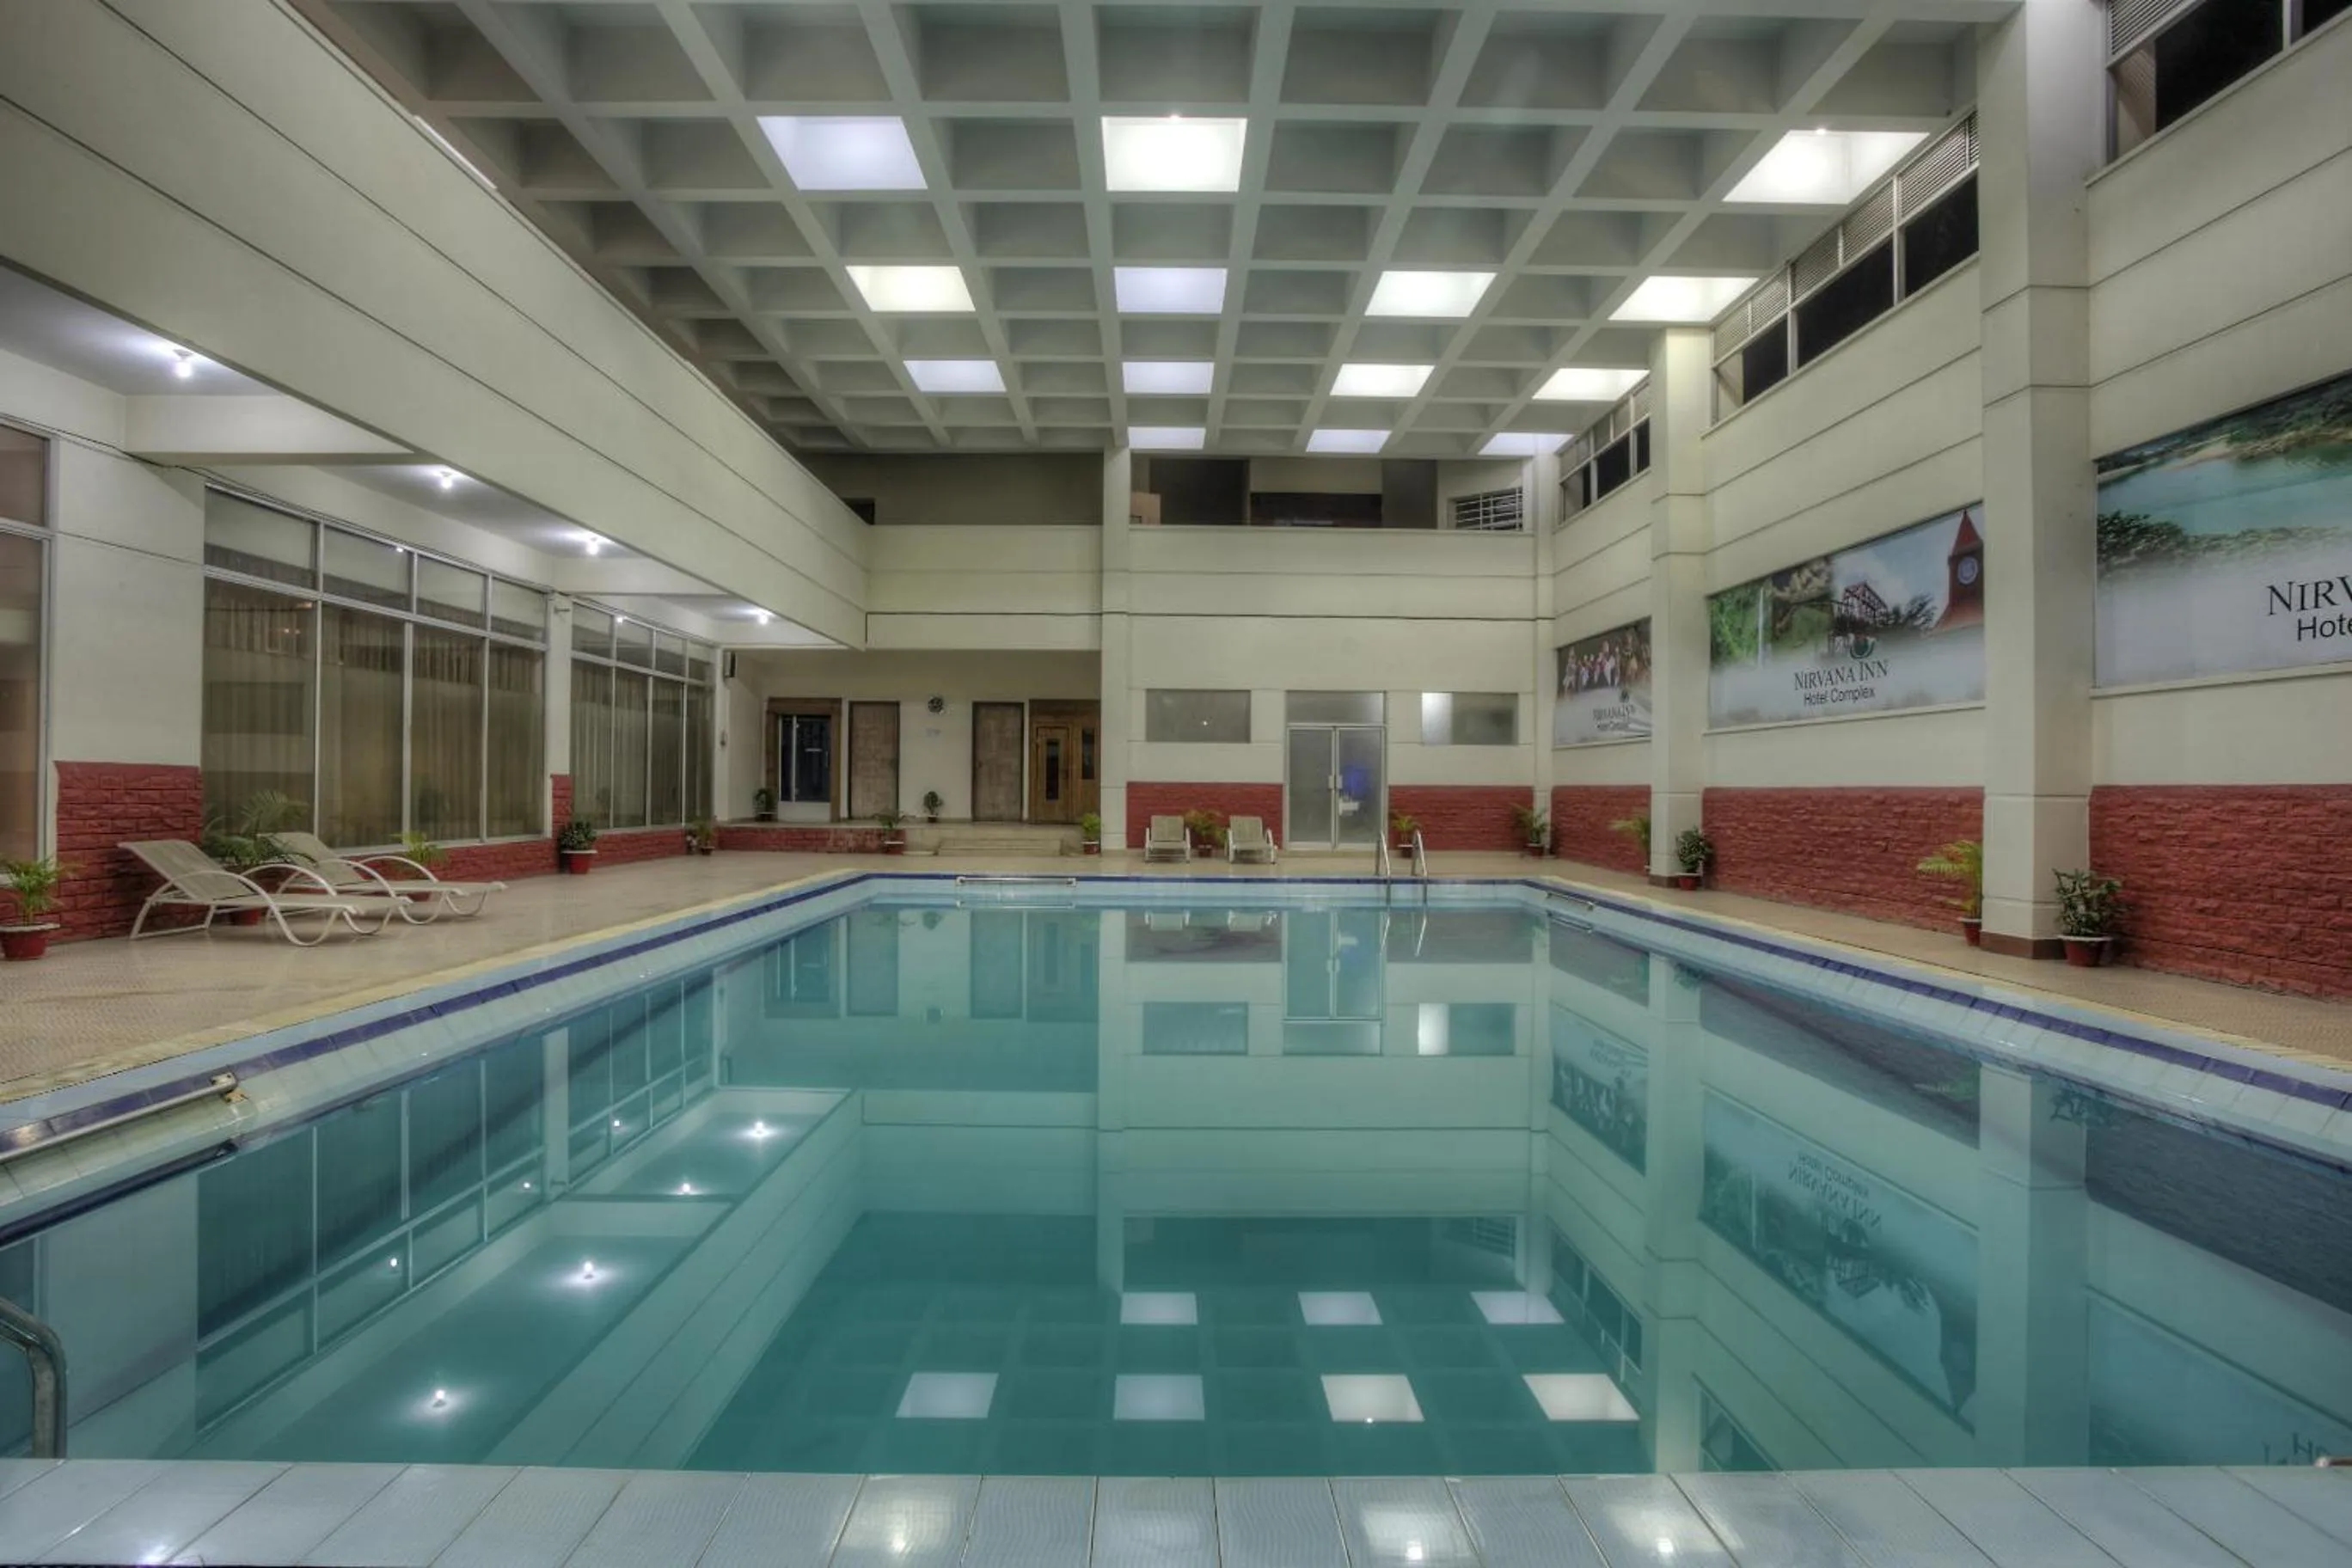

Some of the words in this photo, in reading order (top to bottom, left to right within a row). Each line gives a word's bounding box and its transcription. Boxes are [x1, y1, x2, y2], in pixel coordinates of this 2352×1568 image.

[1793, 666, 1856, 690] NIRVANA
[1859, 659, 1889, 682] INN
[1804, 690, 1828, 706] Hotel
[1830, 685, 1876, 703] Complex
